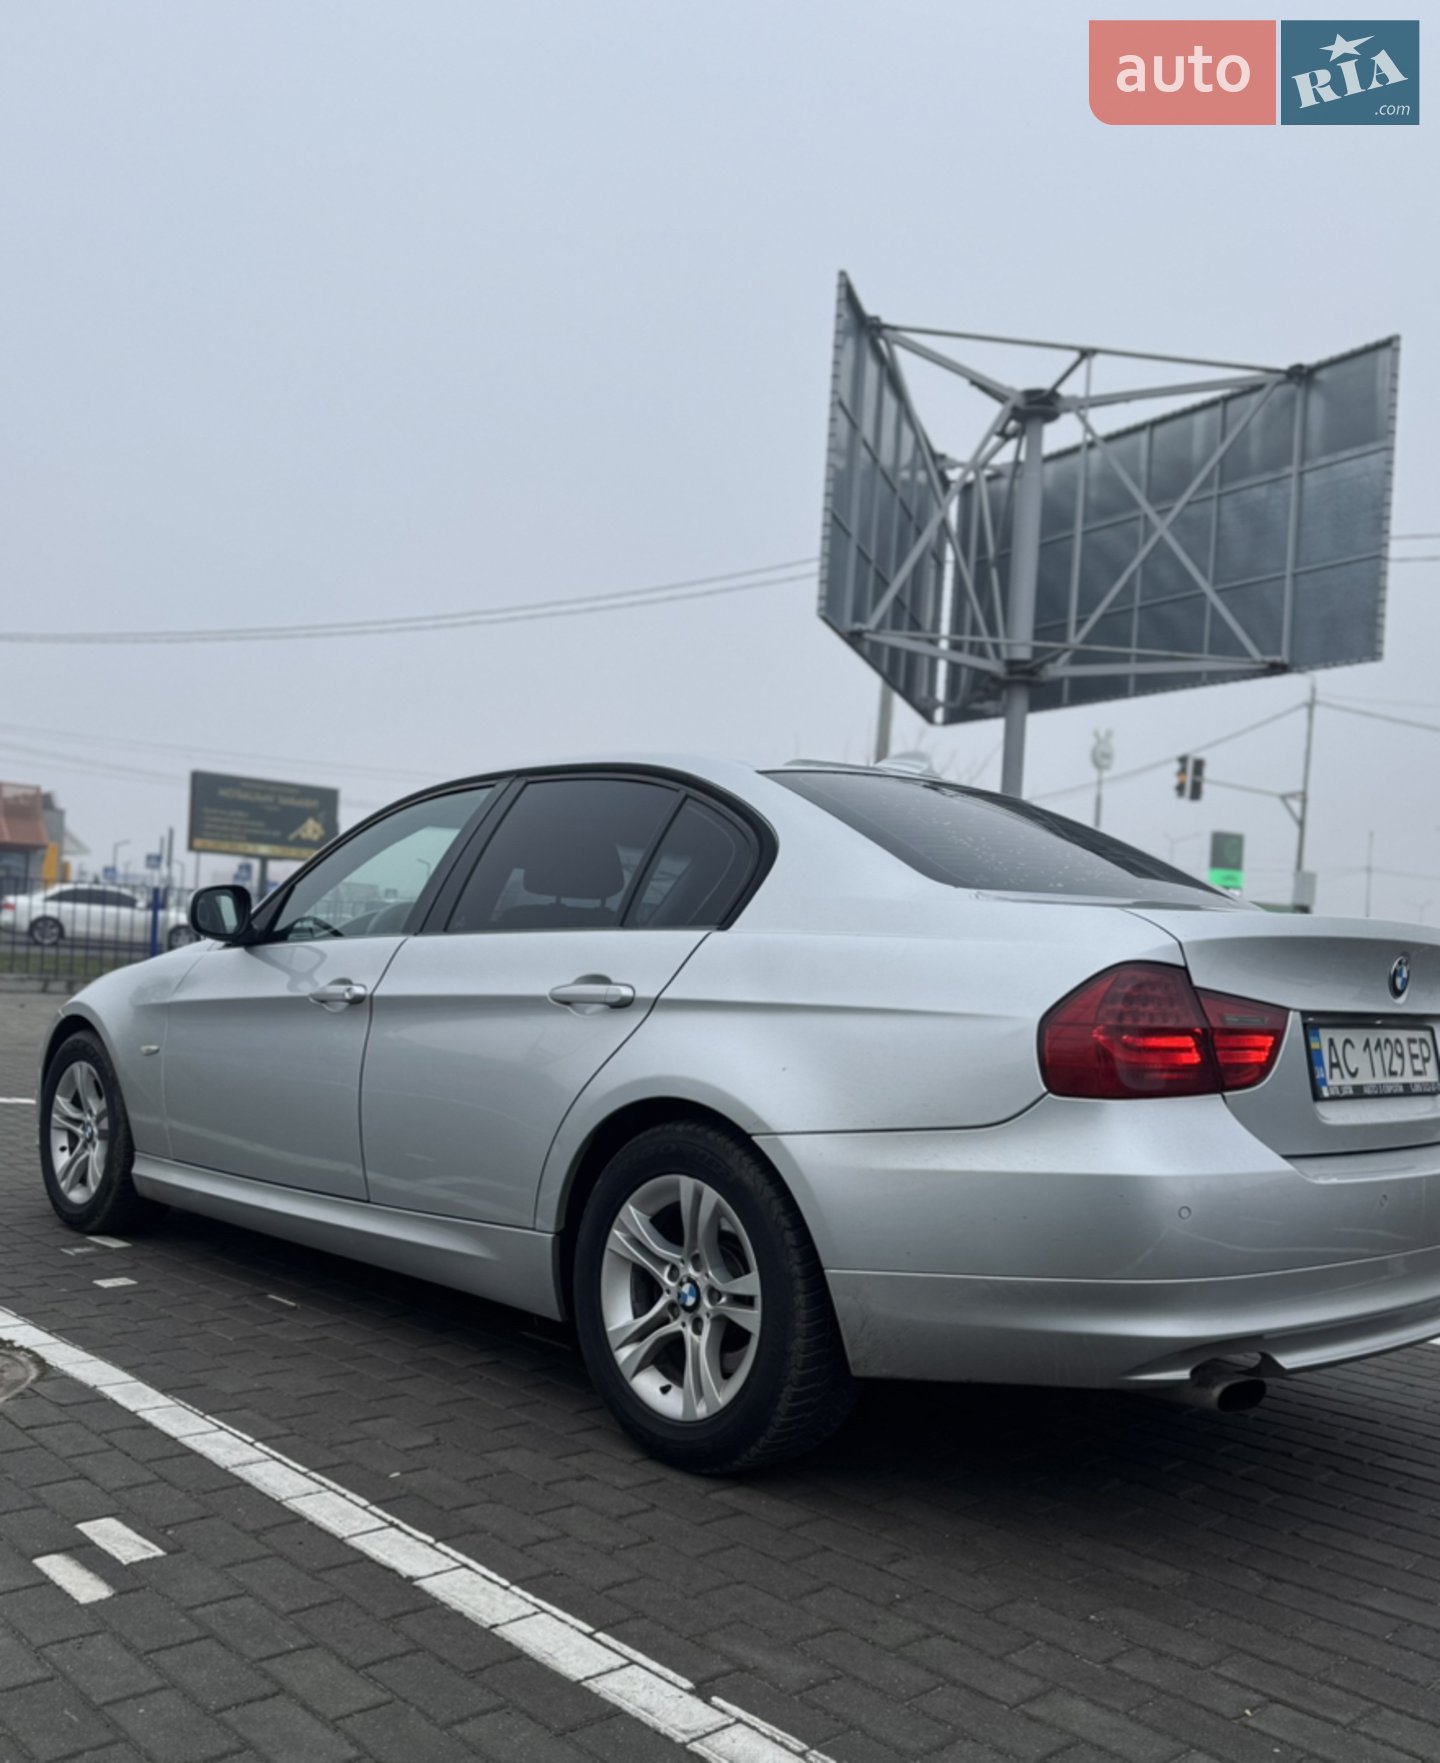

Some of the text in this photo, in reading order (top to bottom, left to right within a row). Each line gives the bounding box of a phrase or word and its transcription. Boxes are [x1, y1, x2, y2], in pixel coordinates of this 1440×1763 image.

[1328, 1037, 1431, 1079] AC 1129 EP
